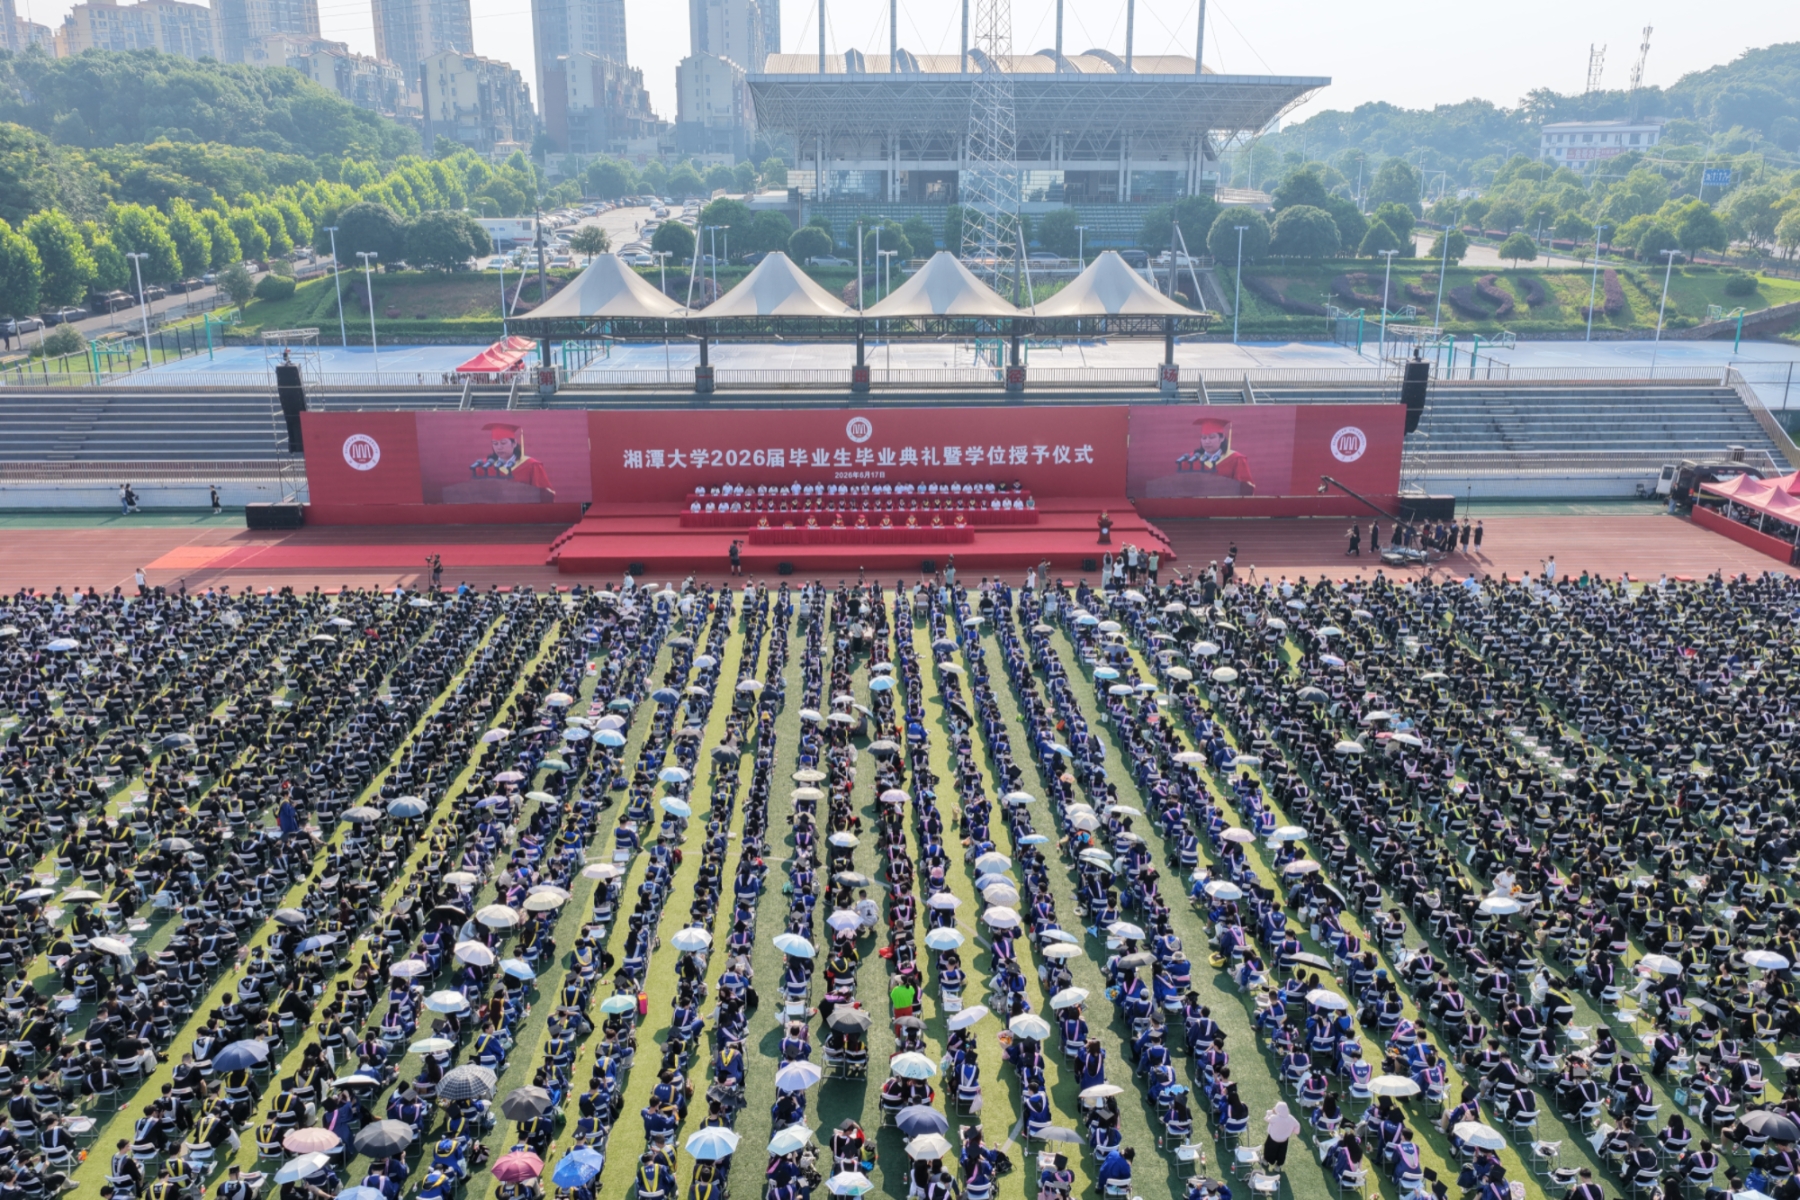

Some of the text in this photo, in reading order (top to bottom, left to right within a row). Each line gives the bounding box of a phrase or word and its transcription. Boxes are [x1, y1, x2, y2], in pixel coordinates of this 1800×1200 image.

[854, 369, 868, 383] 田
[1009, 369, 1023, 384] 径
[1163, 368, 1178, 382] 场
[622, 443, 1094, 469] 湘潭大学2026届毕业生毕业典礼暨学位授予仪式
[834, 471, 886, 479] 2026年6月17日
